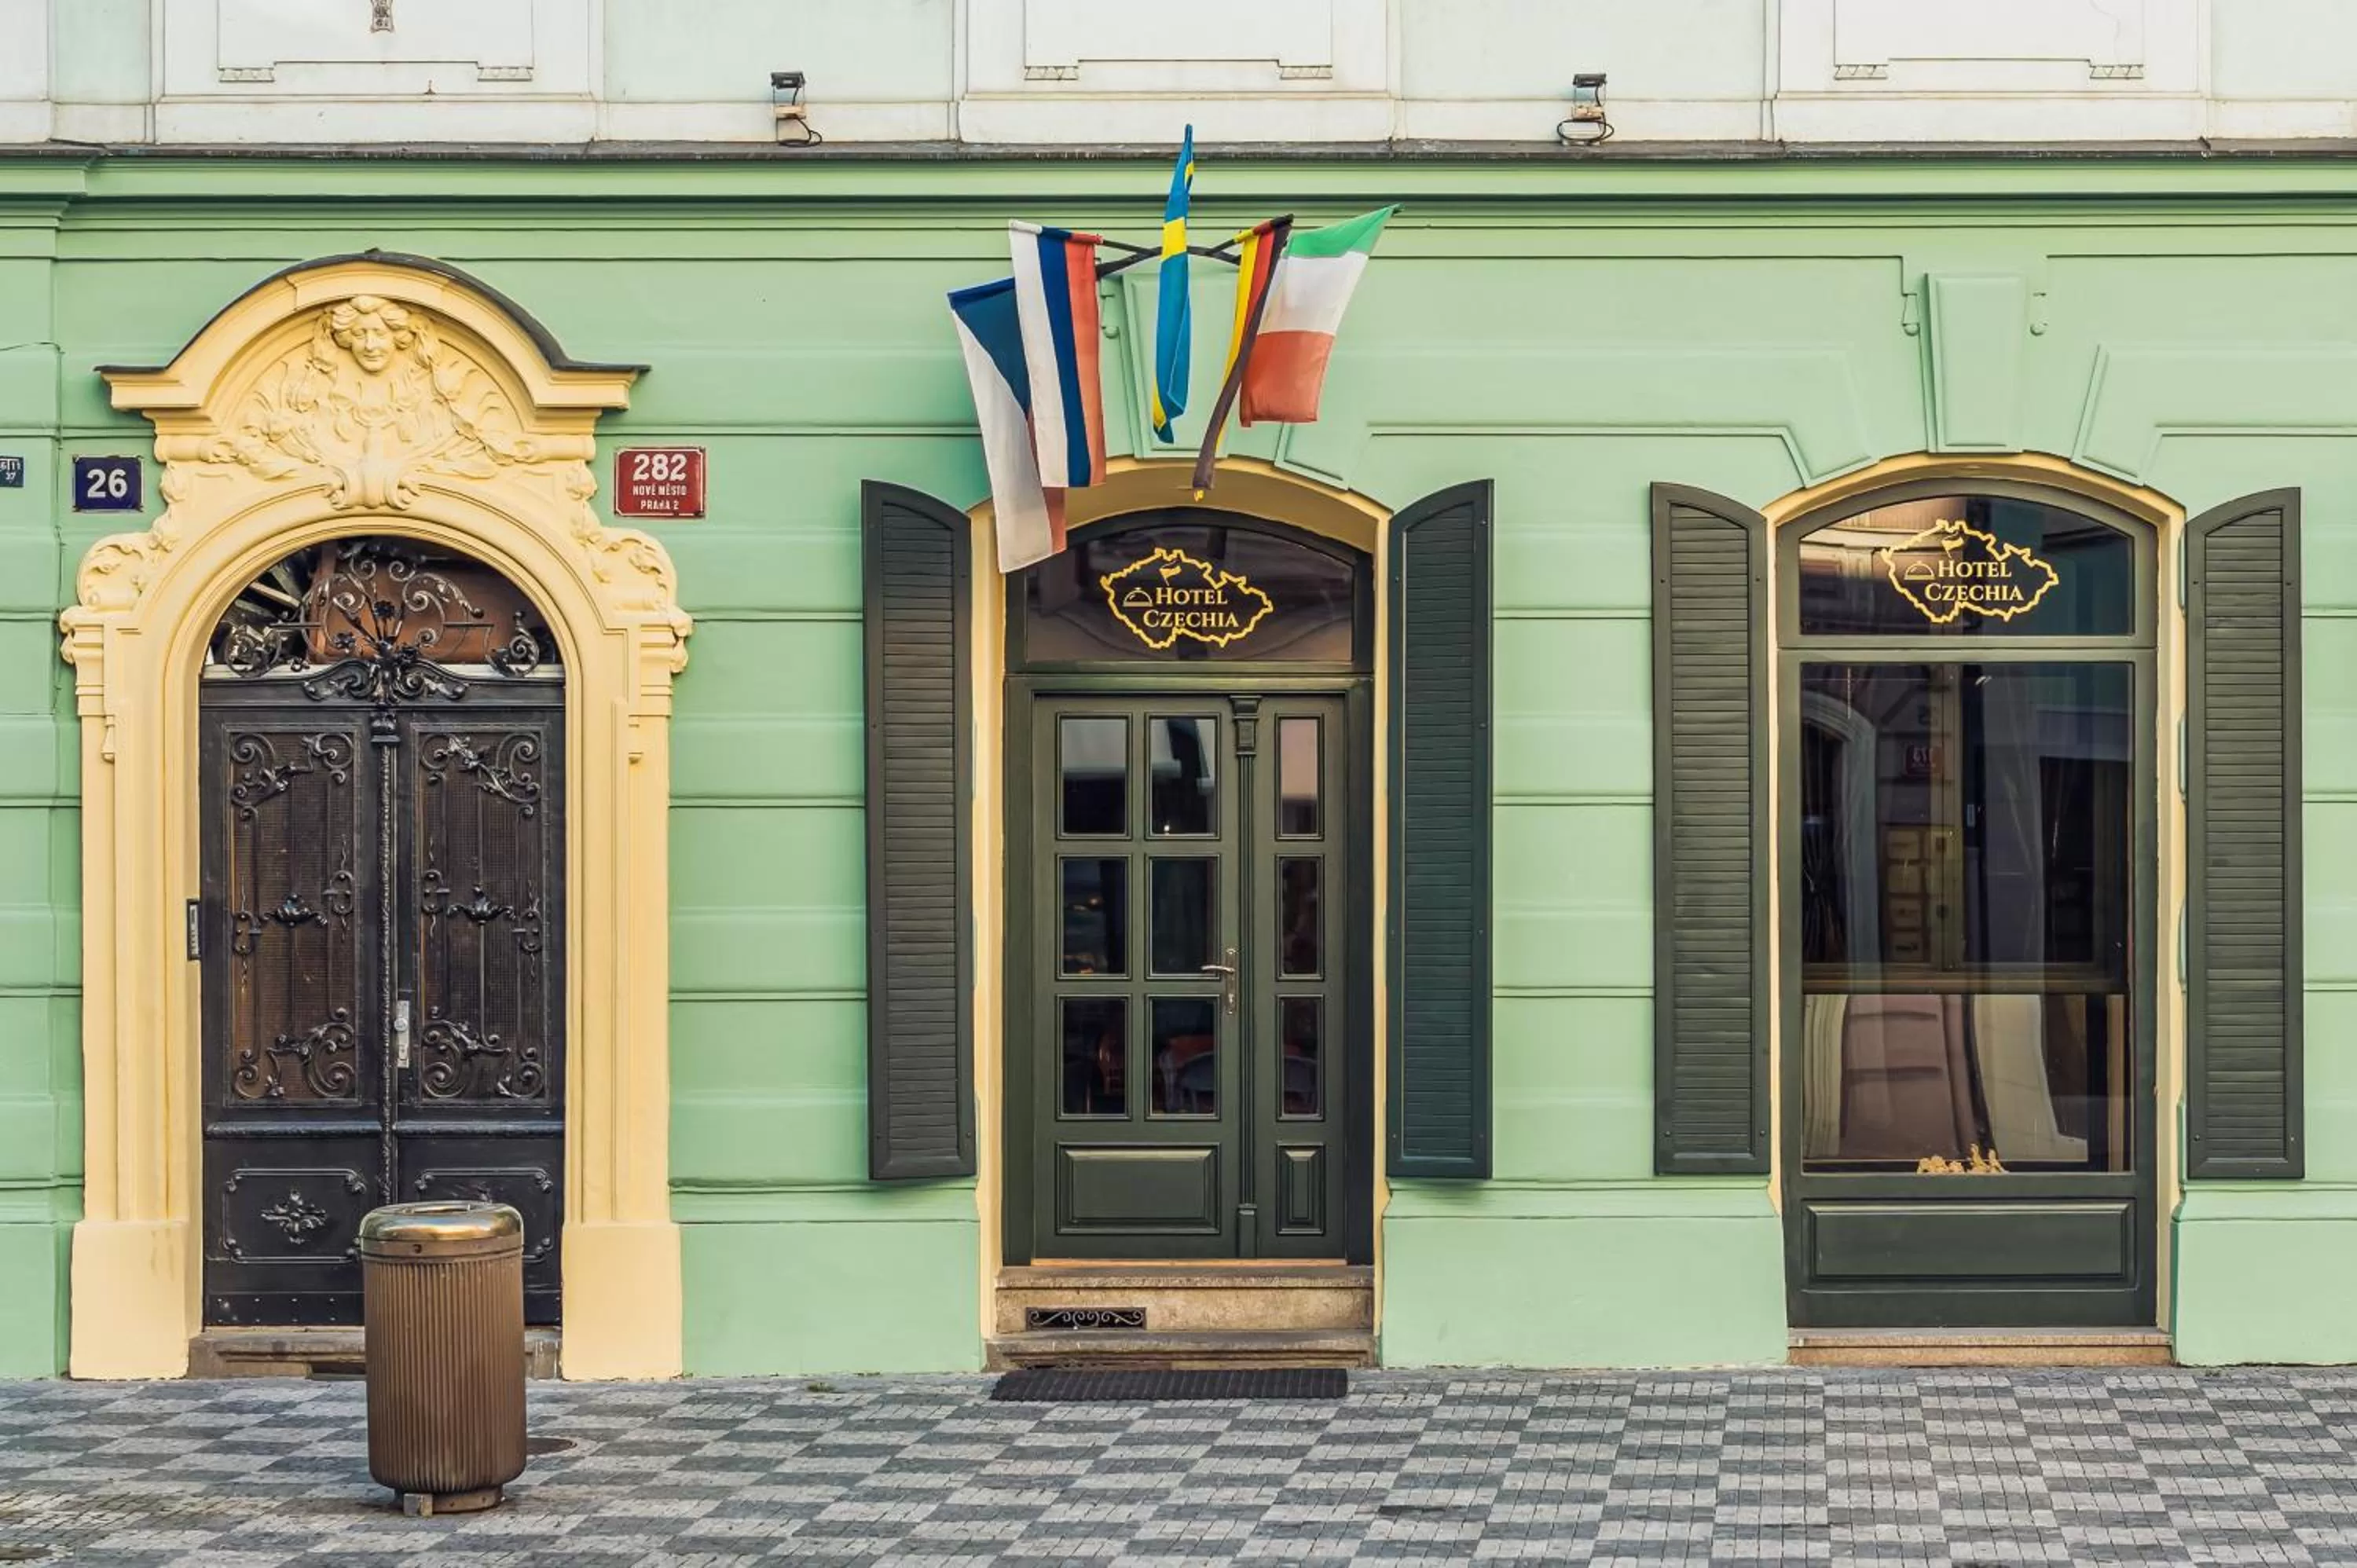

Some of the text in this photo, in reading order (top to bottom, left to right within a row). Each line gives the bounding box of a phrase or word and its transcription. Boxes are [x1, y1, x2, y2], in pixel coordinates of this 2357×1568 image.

[632, 453, 687, 481] 282
[86, 468, 128, 499] 26
[632, 483, 656, 496] NOVÉ
[640, 500, 680, 510] PRAHA 2
[1938, 560, 2012, 578] HOTEL
[1156, 587, 1229, 605] HOTEL
[1925, 583, 2025, 602] CZECHIA
[1143, 609, 1240, 628] CZECHIA
